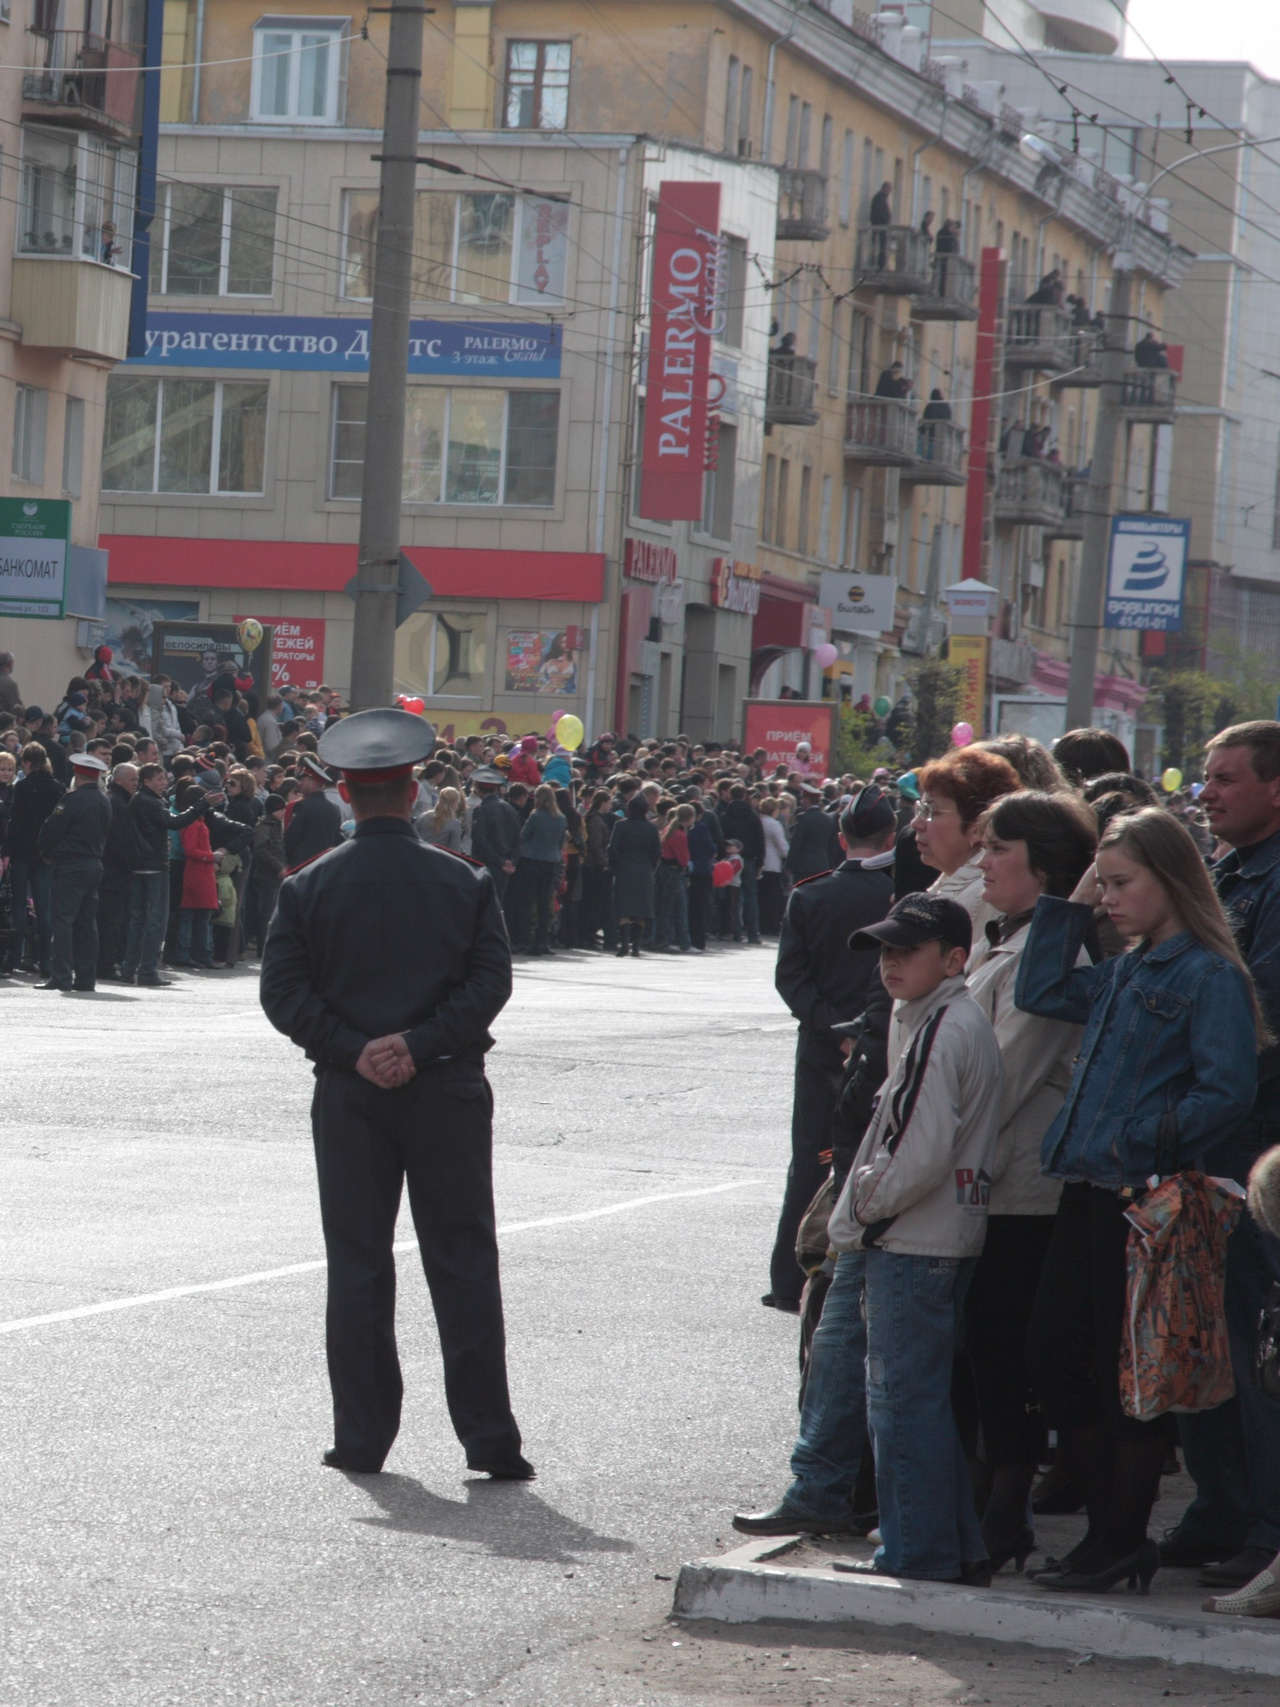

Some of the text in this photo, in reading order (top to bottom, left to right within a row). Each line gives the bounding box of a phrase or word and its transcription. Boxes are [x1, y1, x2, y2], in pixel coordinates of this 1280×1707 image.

[533, 203, 553, 294] REPLAY
[691, 228, 730, 336] Grand
[145, 330, 338, 357] урагентство
[464, 336, 537, 351] PALERMO
[464, 353, 498, 365] этаж
[504, 348, 547, 362] Grand
[658, 248, 702, 458] PALERMO
[632, 539, 678, 586] PALERMO
[274, 622, 300, 636] ИЁМ
[165, 641, 231, 651] ВЕЛОСИПЕДЫ
[272, 652, 315, 661] ЕРАТОРЫ
[766, 730, 812, 743] ПРИЁМ
